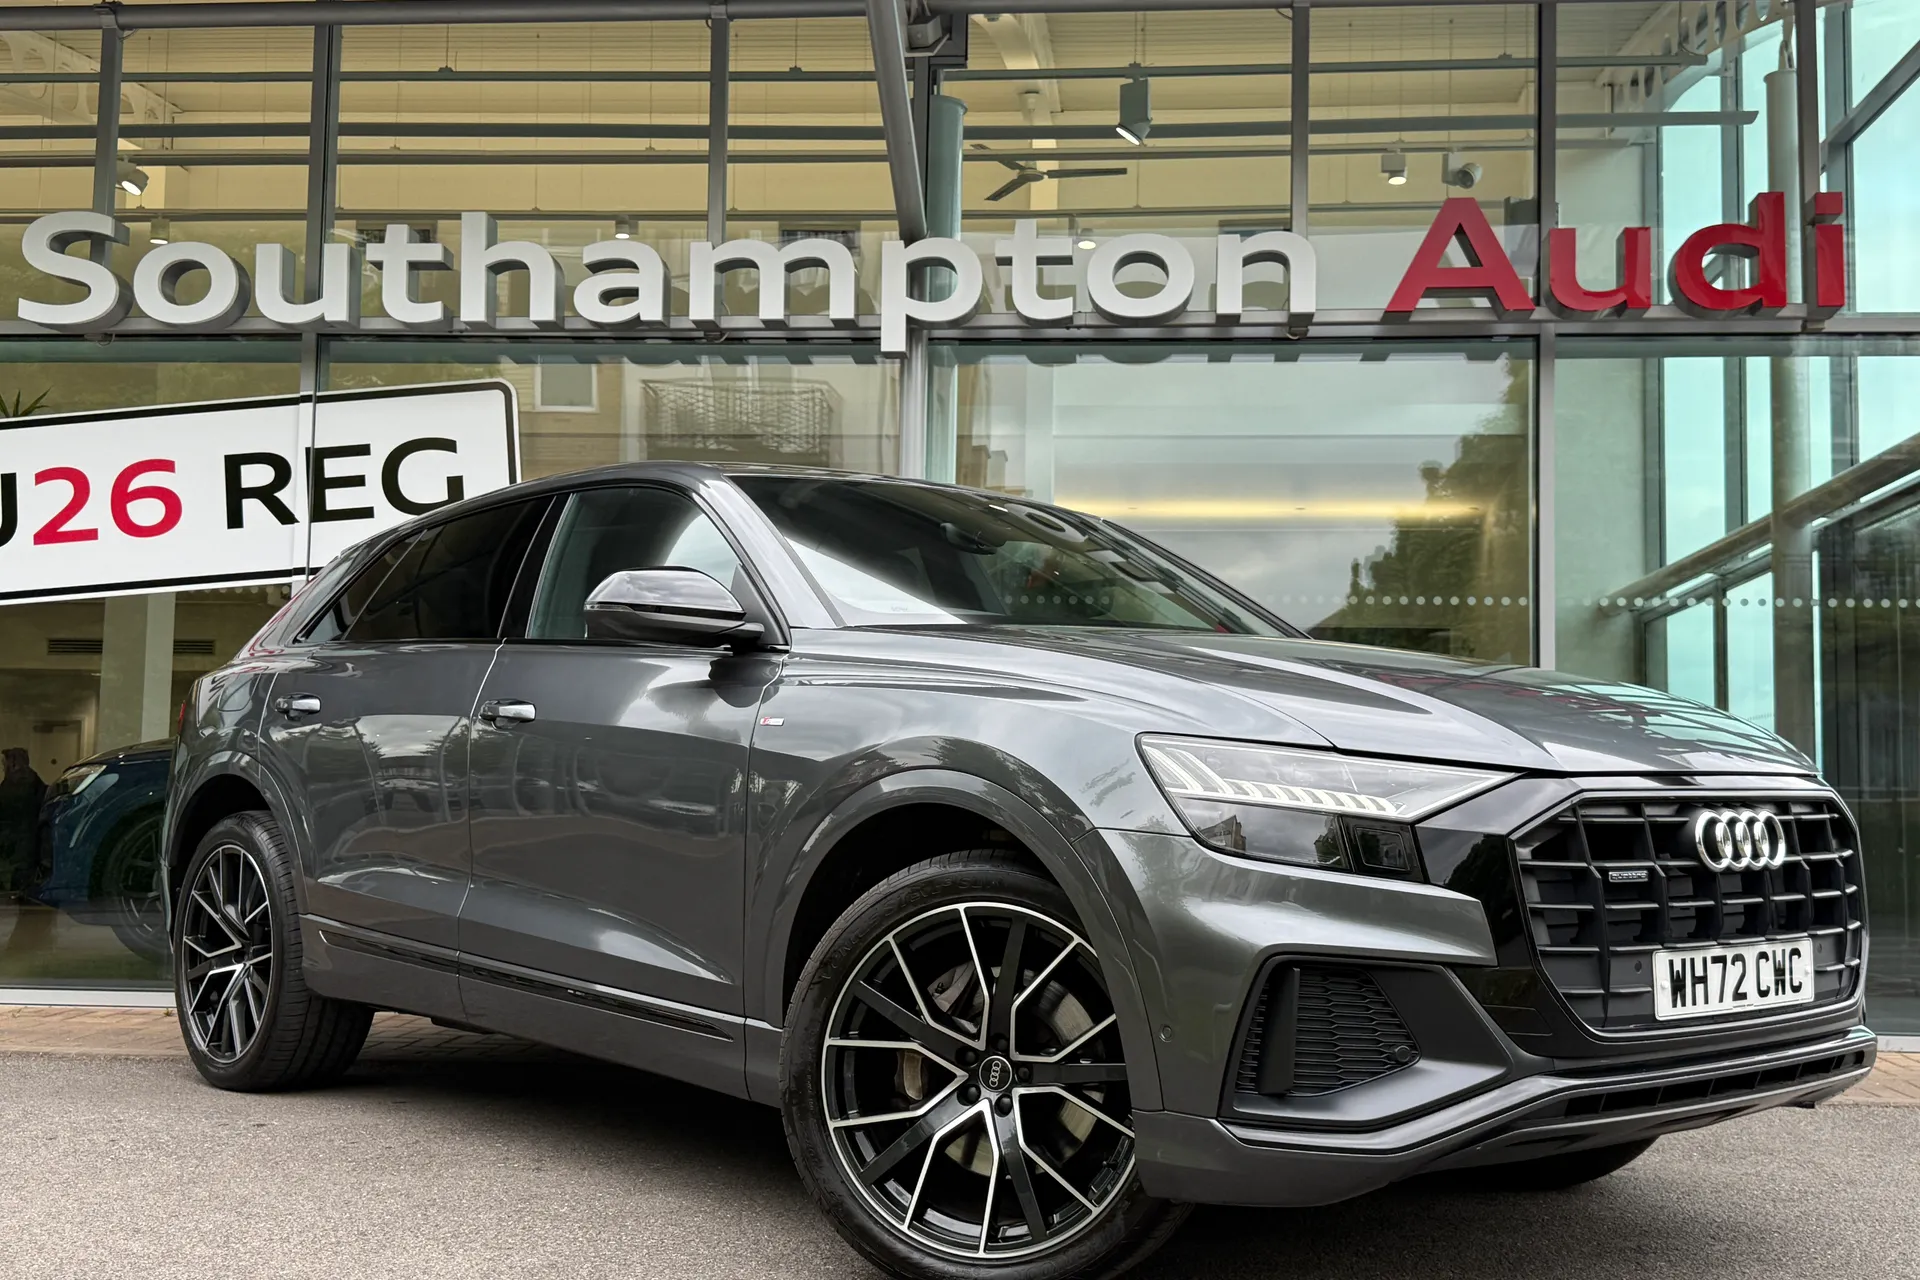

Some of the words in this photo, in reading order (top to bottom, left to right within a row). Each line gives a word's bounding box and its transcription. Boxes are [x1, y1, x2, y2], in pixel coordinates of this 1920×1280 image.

[18, 211, 1317, 357] Southampton
[1383, 192, 1845, 318] Audi
[0, 458, 182, 547] 26
[224, 437, 465, 528] REG
[1668, 953, 1748, 1008] WH72
[1755, 947, 1803, 998] CWC
